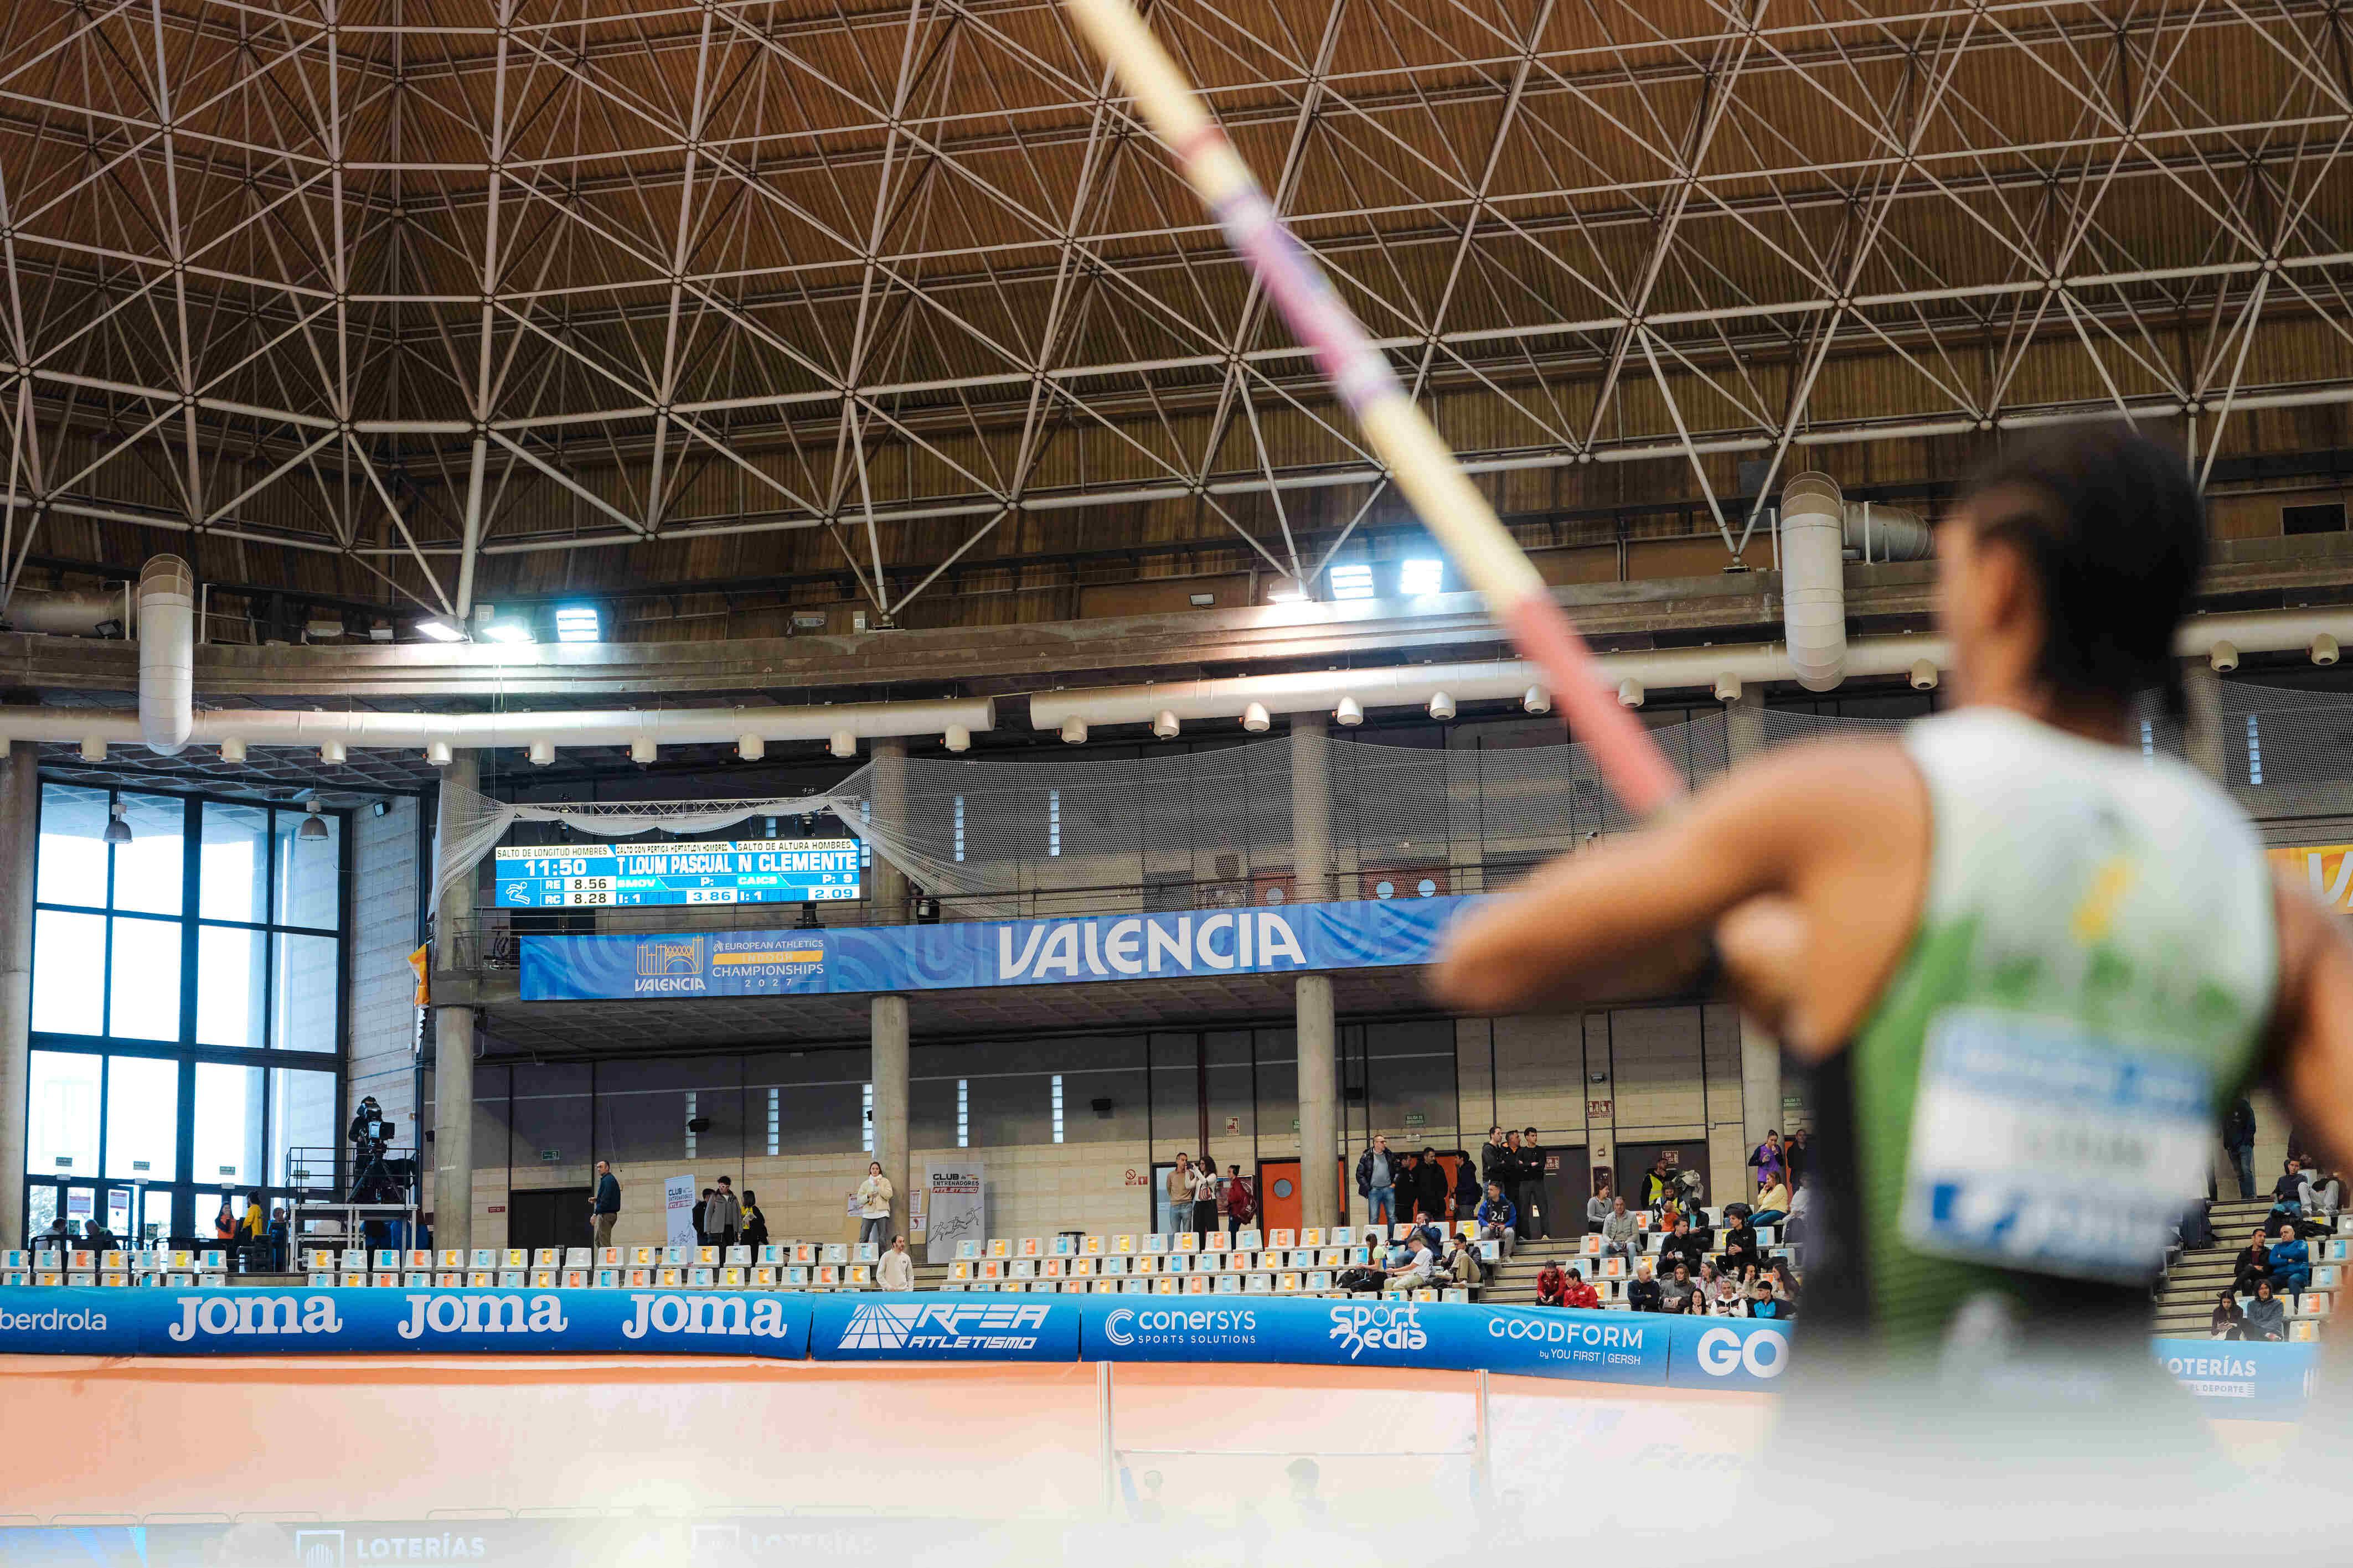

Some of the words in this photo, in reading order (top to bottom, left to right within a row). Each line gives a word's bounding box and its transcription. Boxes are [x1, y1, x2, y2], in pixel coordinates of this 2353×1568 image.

[779, 842, 809, 850] ALTURA
[812, 841, 850, 850] HOMBRES
[534, 848, 570, 856] LONGITUD
[572, 847, 607, 856] HOMBRES
[617, 857, 625, 875] T
[629, 856, 667, 874] LOUM
[671, 855, 732, 873] PASCUAL
[739, 854, 753, 872] N
[758, 852, 857, 872] CLEMENTE
[524, 859, 587, 877] 11:50
[545, 880, 561, 889] RE
[575, 879, 606, 889] 8.56
[700, 877, 714, 886] P:
[545, 894, 561, 904] RC
[575, 894, 606, 904] 8.28
[693, 891, 731, 901] 3.86
[815, 889, 853, 898] 2.09
[725, 941, 776, 950] EUROPEAN
[776, 940, 823, 948] ATHLETICS
[999, 912, 1307, 979] VALENCIA
[743, 953, 793, 962] INDOOR
[713, 964, 823, 977] CHAMPIONSHIPS
[635, 977, 706, 992] VALENCIA
[745, 979, 792, 987] 2027
[1492, 1211, 1504, 1222] 24
[916, 1304, 1051, 1335] RFEA
[1488, 1317, 1643, 1349] GOODFORM
[908, 1336, 1037, 1349] ATLETISMO
[1138, 1335, 1184, 1344] SPORTS
[1191, 1335, 1256, 1344] SOLUTIONS
[1540, 1350, 1549, 1359] by
[1551, 1349, 1571, 1359] YOU
[1573, 1351, 1600, 1362] FIRST
[1608, 1354, 1640, 1365] GERSH
[2158, 1355, 2256, 1376] OTERÍAS
[2203, 1384, 2244, 1393] DEPORTE
[356, 1532, 487, 1559] LOTERÍAS
